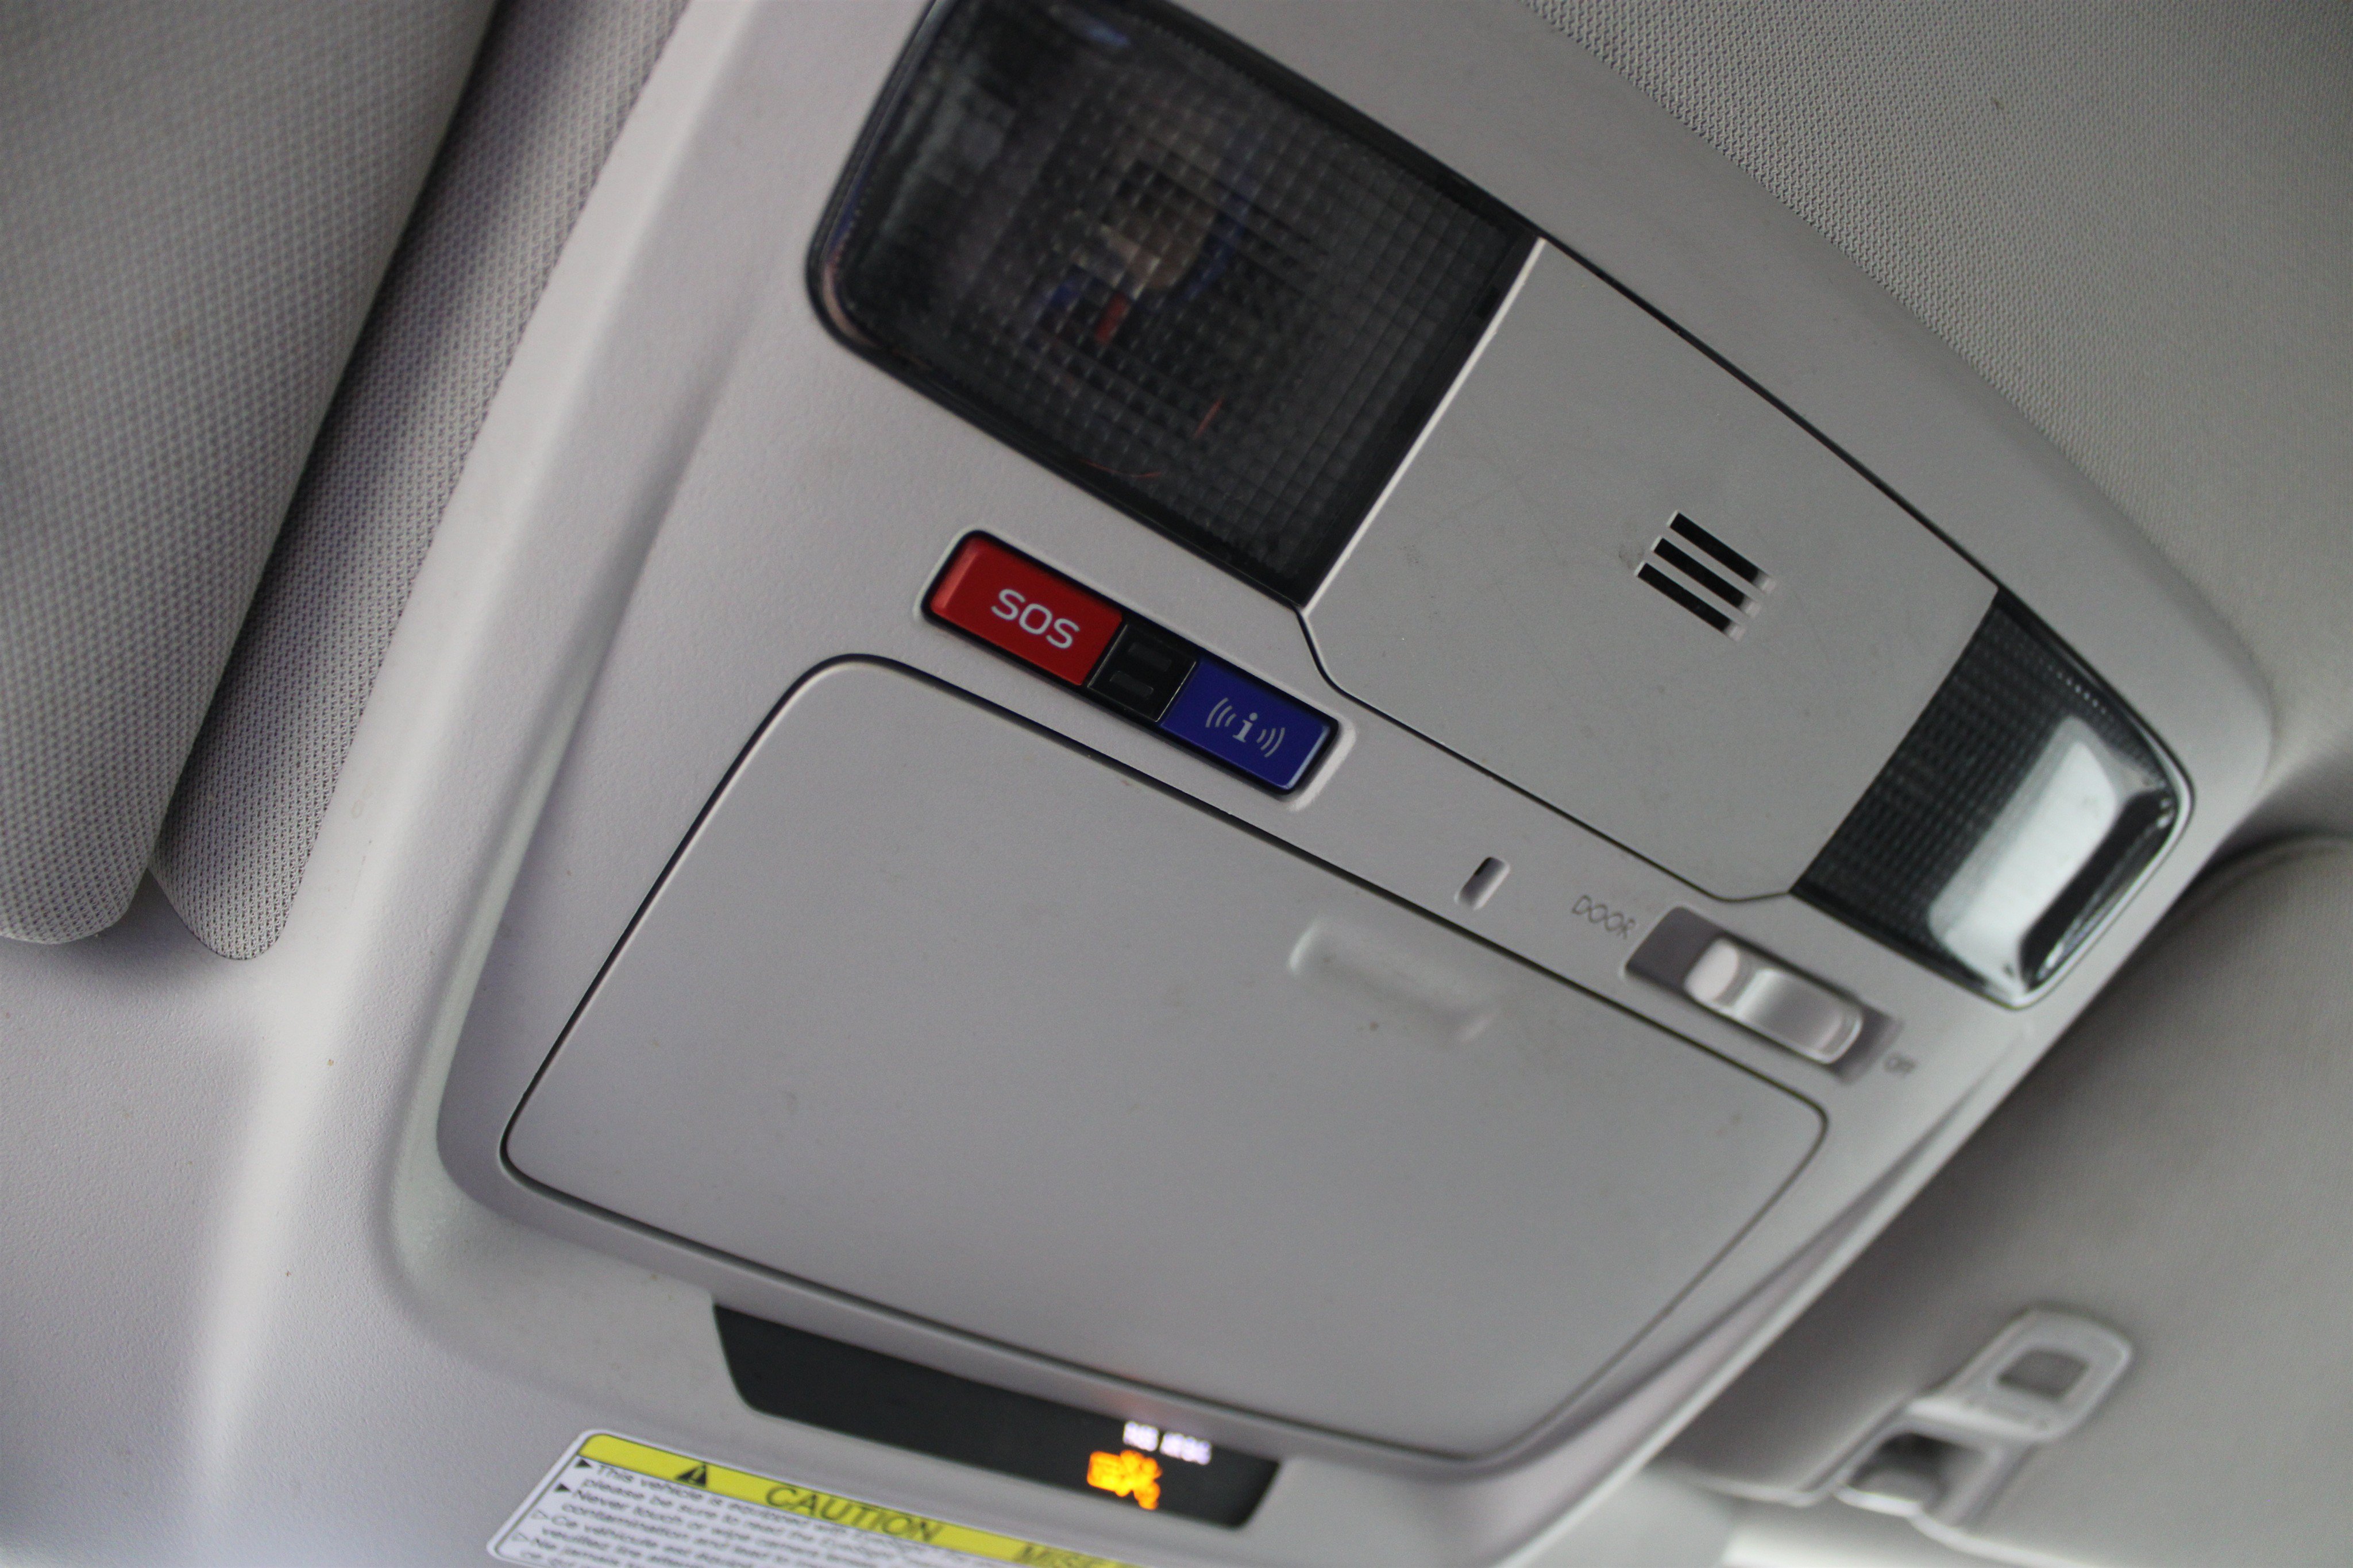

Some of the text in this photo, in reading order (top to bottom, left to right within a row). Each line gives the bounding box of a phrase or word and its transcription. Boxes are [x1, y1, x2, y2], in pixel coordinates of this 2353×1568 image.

[991, 589, 1080, 648] SOS
[1572, 895, 1635, 939] DOOR
[766, 1486, 943, 1542] CAUTION
